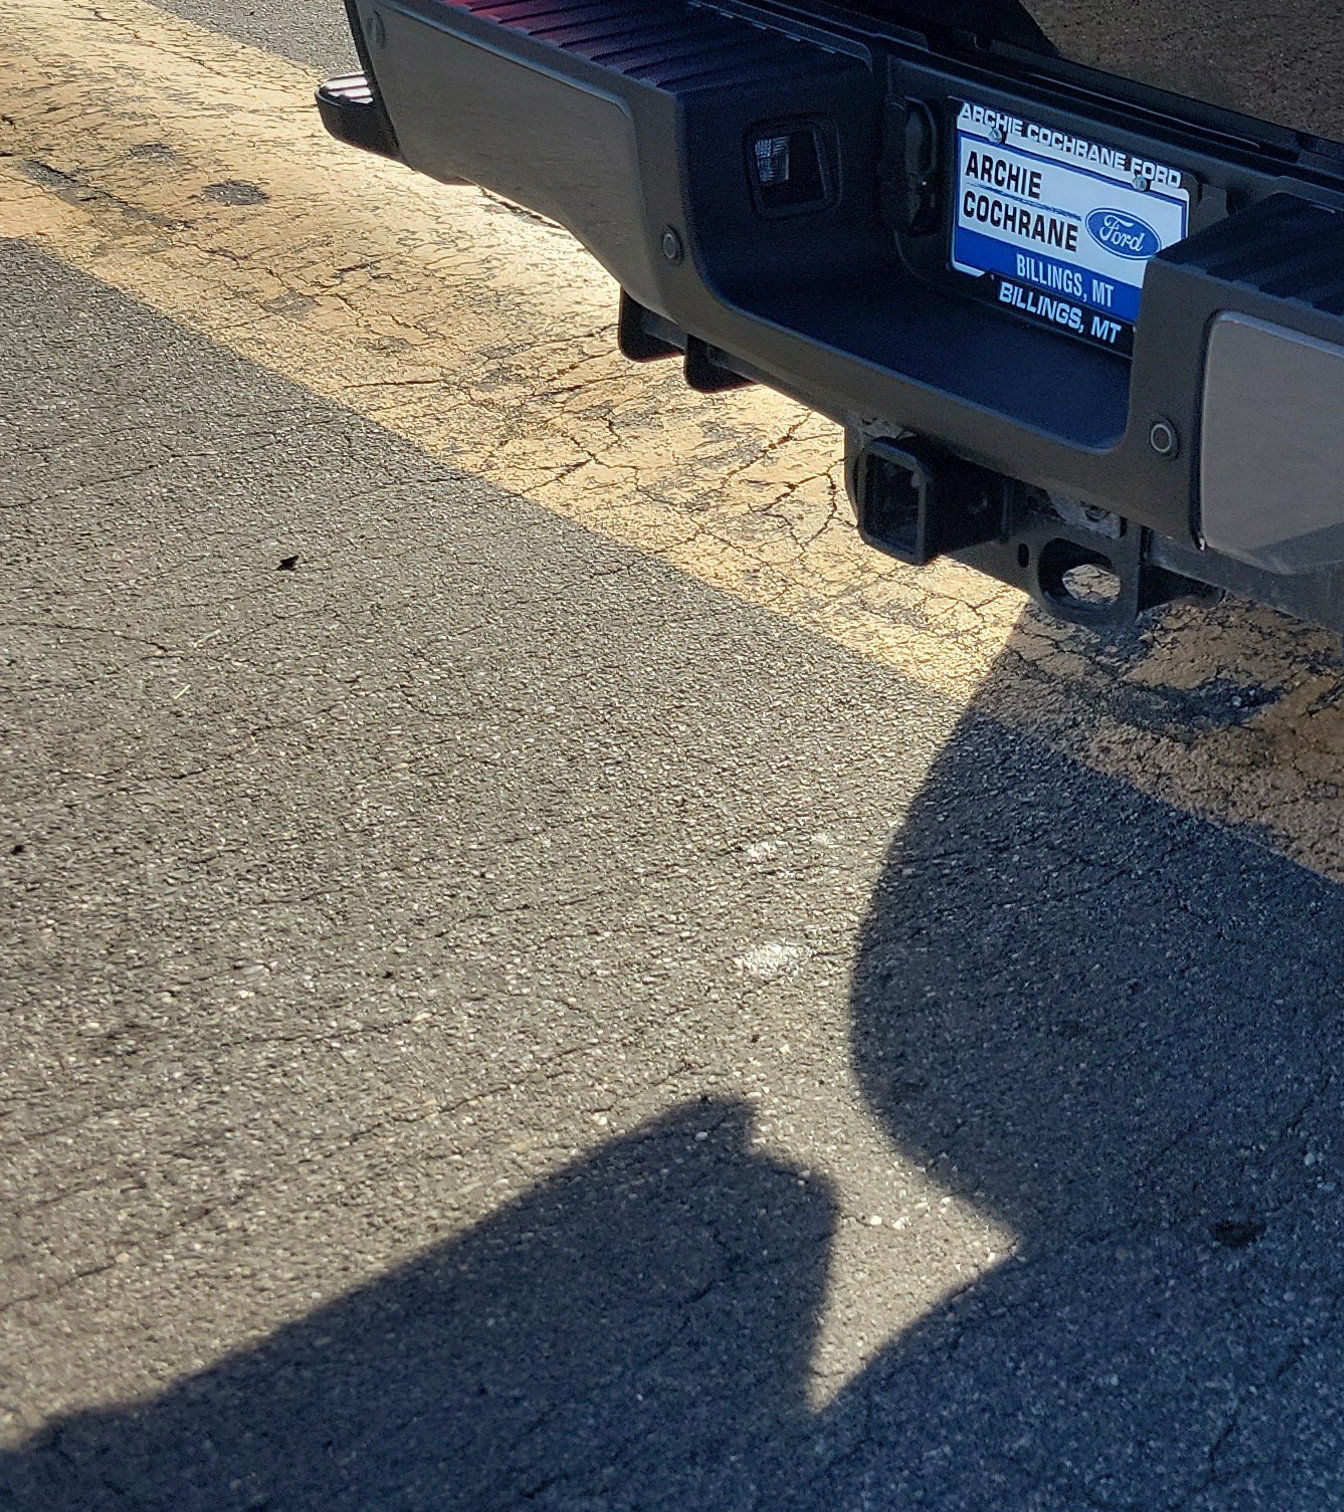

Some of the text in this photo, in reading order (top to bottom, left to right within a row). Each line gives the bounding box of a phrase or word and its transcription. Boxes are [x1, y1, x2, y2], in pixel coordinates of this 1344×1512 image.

[959, 102, 1182, 188] ARCHIE COCHRANE FORD
[965, 150, 1043, 199] ARCHIE
[963, 190, 1079, 253] COCHRANE
[1100, 216, 1144, 253] Ford
[1016, 253, 1115, 308] BILLINGS, MT
[998, 281, 1122, 344] BILLINGS, MT
